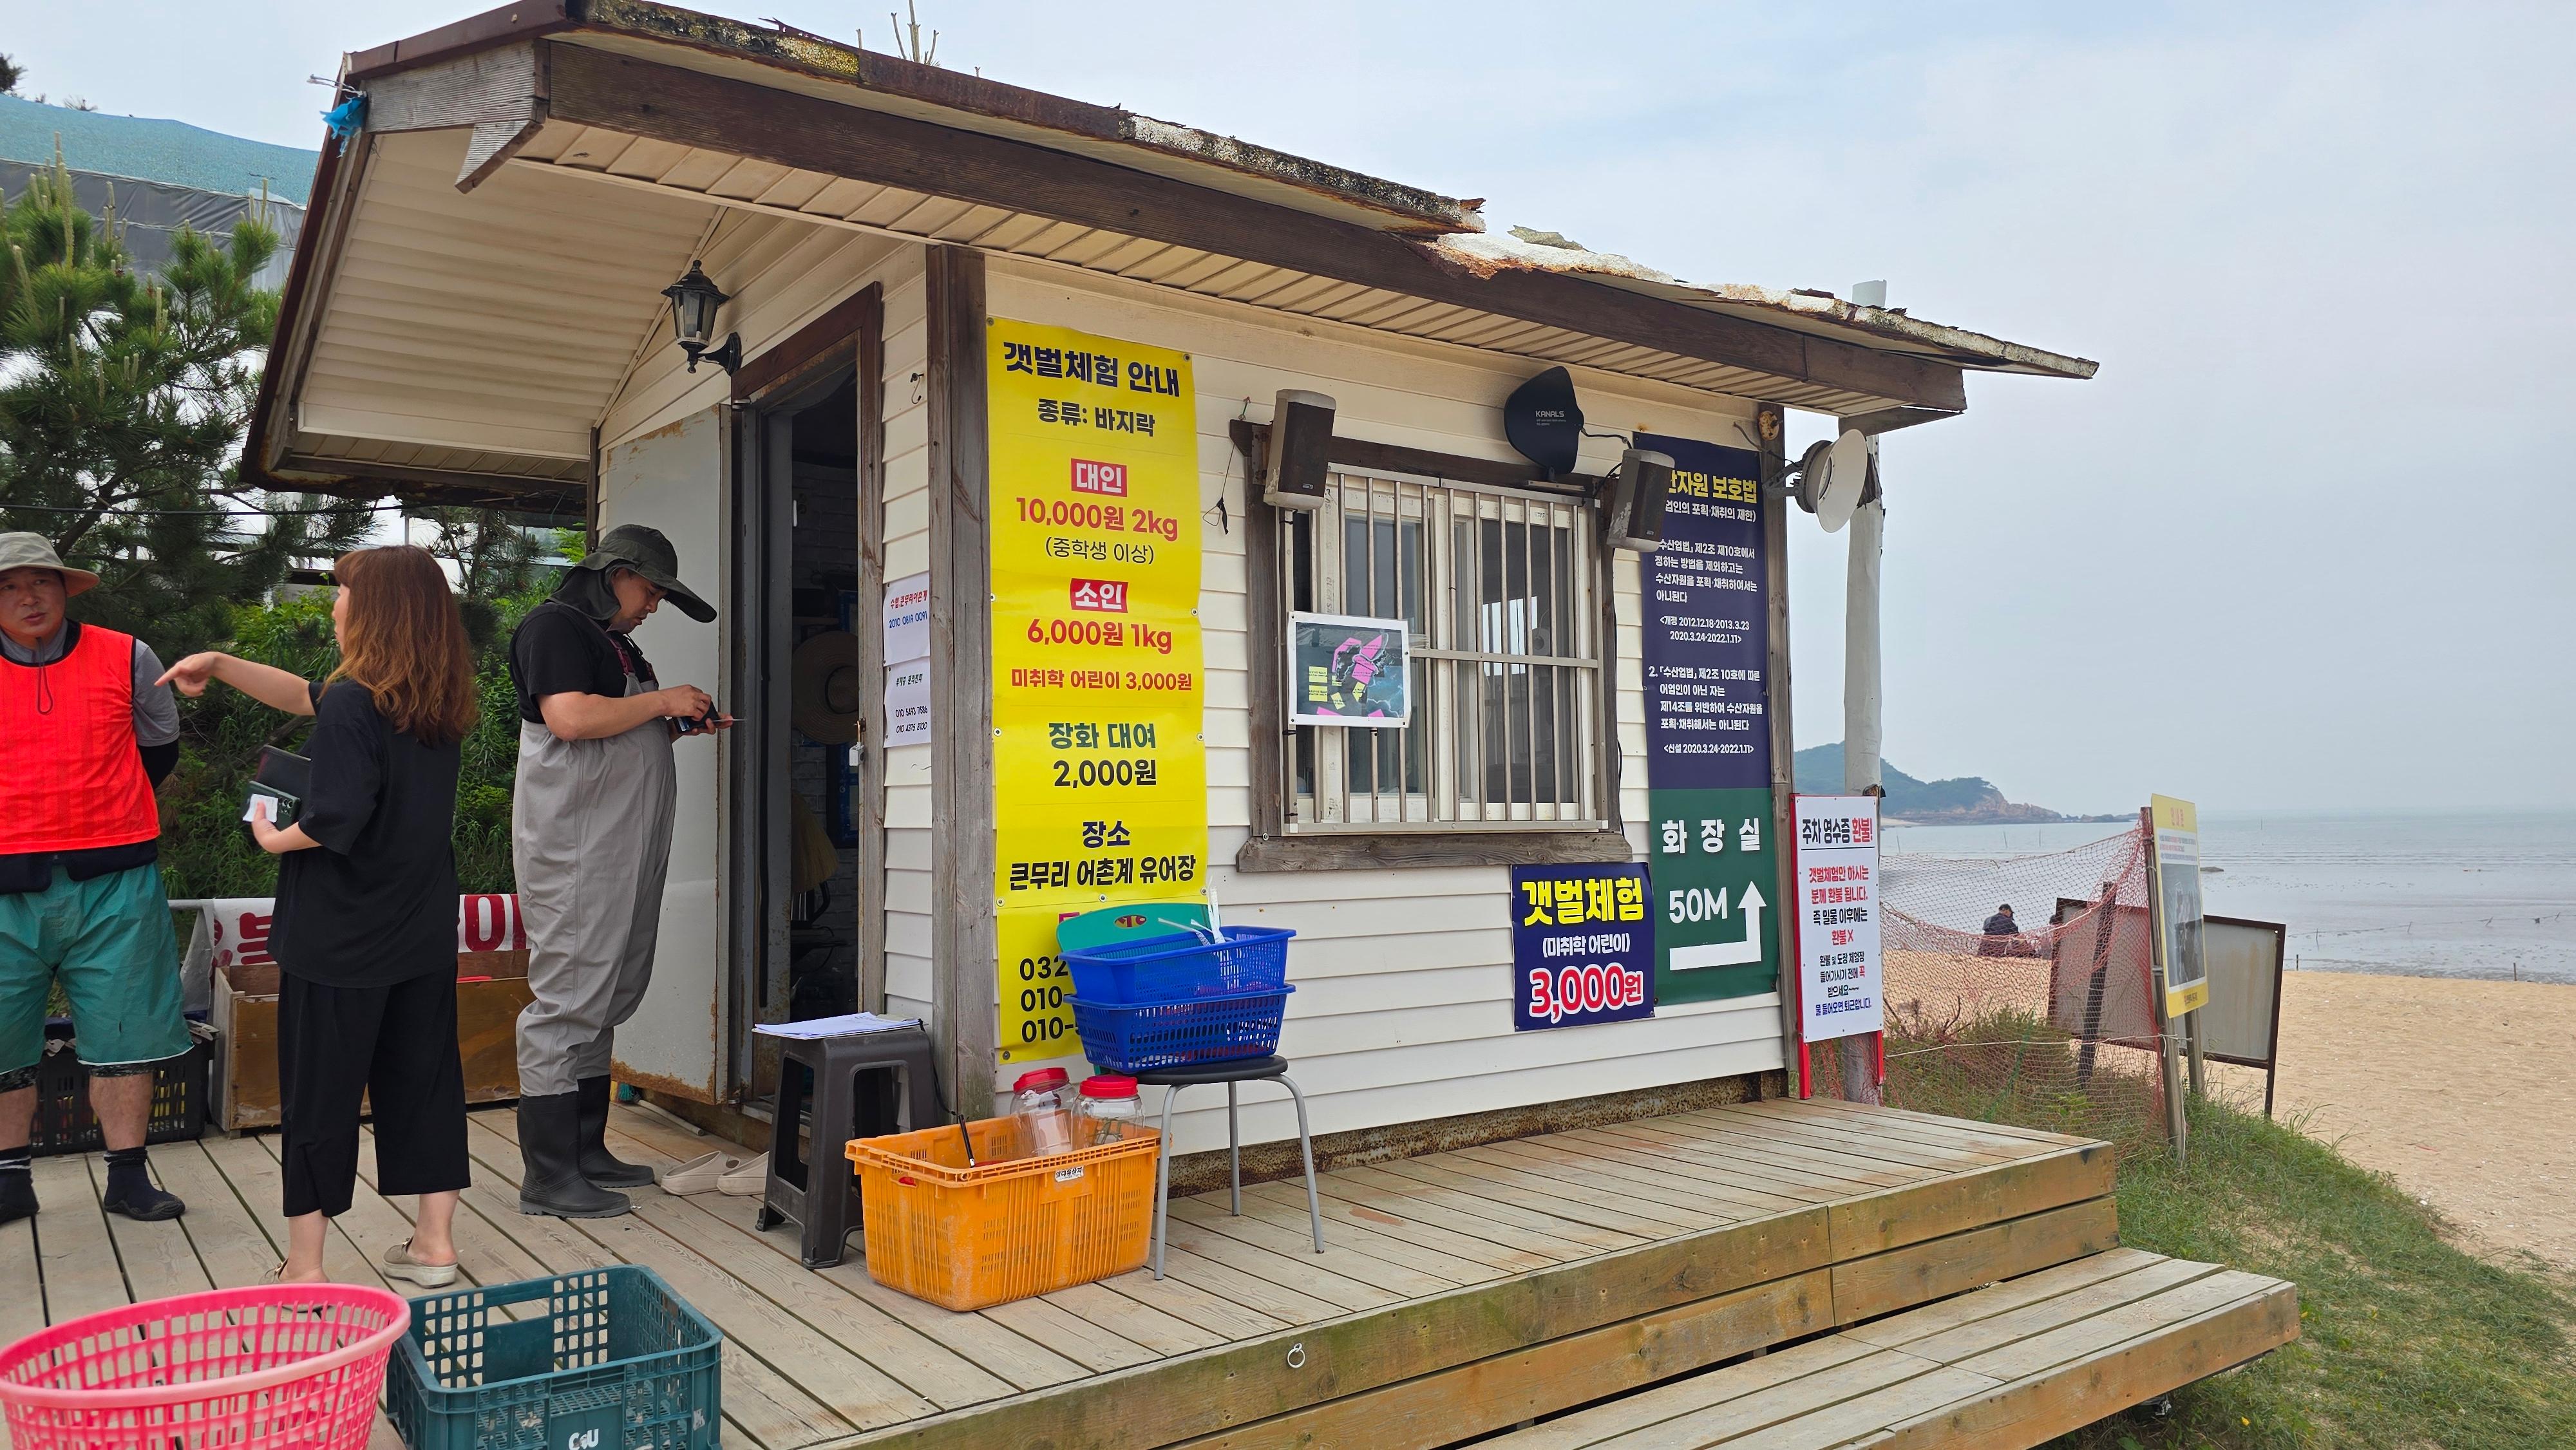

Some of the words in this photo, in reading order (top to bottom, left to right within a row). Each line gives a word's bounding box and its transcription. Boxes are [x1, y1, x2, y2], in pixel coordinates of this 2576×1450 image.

[1003, 341, 1118, 388] 갯벌체험
[1128, 362, 1180, 397] 안내
[1038, 398, 1088, 426] 종류:
[1095, 407, 1155, 437] 바지락
[1075, 462, 1122, 493] 대인
[1712, 475, 1757, 504] 보호법
[1016, 497, 1124, 531] 10,000원
[1132, 509, 1179, 541] 2kg
[1737, 509, 1756, 523] 제한)
[1046, 536, 1107, 561] (중학생
[1113, 543, 1155, 565] 이상)
[1694, 542, 1716, 555] 제2조
[1717, 545, 1756, 559] 제10호에서
[1654, 555, 1679, 569] 정하는
[1680, 558, 1703, 570] 방법을
[1705, 560, 1743, 574] 제외하고는
[1655, 572, 1694, 587] 수산자원을
[1075, 582, 1123, 610] 소인
[1656, 590, 1688, 603] 아니된다
[889, 617, 901, 628] 2010
[915, 610, 927, 622] 0091
[1027, 618, 1124, 646] 6,000원
[1130, 624, 1172, 654] 1kg
[1012, 668, 1065, 688] 미취학
[1070, 670, 1120, 689] 어린이
[1126, 672, 1192, 691] 3,000원
[1648, 666, 1658, 677] 2.
[1698, 668, 1719, 679] 제2조
[1721, 669, 1746, 681] 10호에
[1747, 670, 1760, 681] 따른
[1660, 683, 1690, 695] 어업인이
[1692, 684, 1707, 696] 아닌
[1709, 685, 1725, 696] 자는
[895, 708, 905, 718] 010
[1660, 701, 1692, 712] 제14조를
[1694, 702, 1725, 713] 위반하여
[1727, 702, 1763, 715] 수산자원을
[896, 724, 905, 733] 010
[1718, 719, 1750, 731] 아니된다
[1048, 722, 1099, 749] 장화
[1107, 723, 1156, 749] 대여
[1053, 759, 1157, 789] 2,000원
[1082, 820, 1130, 849] 장소
[1803, 818, 1821, 845] 주차
[1823, 818, 1850, 844] 영수증
[1852, 817, 1873, 843] 환불!
[1009, 860, 1070, 891] 큰무리
[1077, 857, 1133, 887] 어촌계
[1139, 854, 1197, 884] 유어장
[1809, 865, 1846, 883] 갯벌체험만
[1847, 865, 1869, 881] 하시는
[1522, 877, 1643, 927] 갯벌체험
[1828, 887, 1842, 903] 환불
[1844, 885, 1868, 902] 됩니다.
[1669, 887, 1728, 924] 50M
[1813, 910, 1821, 926] 즉
[1839, 907, 1868, 924] 이후에는
[1542, 935, 1587, 958] (미취학
[1588, 932, 1631, 954] 어린이)
[1832, 929, 1846, 946] 환불
[1848, 928, 1853, 943] X
[1819, 954, 1831, 966] 환불
[1837, 952, 1848, 965] 도장
[1848, 951, 1864, 963] 체험장
[1820, 968, 1847, 983] 들어가시기
[1848, 967, 1859, 979] 전에
[1530, 963, 1643, 1022] 3,000원
[1815, 1004, 1821, 1017] 물
[1822, 1001, 1843, 1015] 들어오면
[1844, 997, 1872, 1012] 퇴근합니다.
